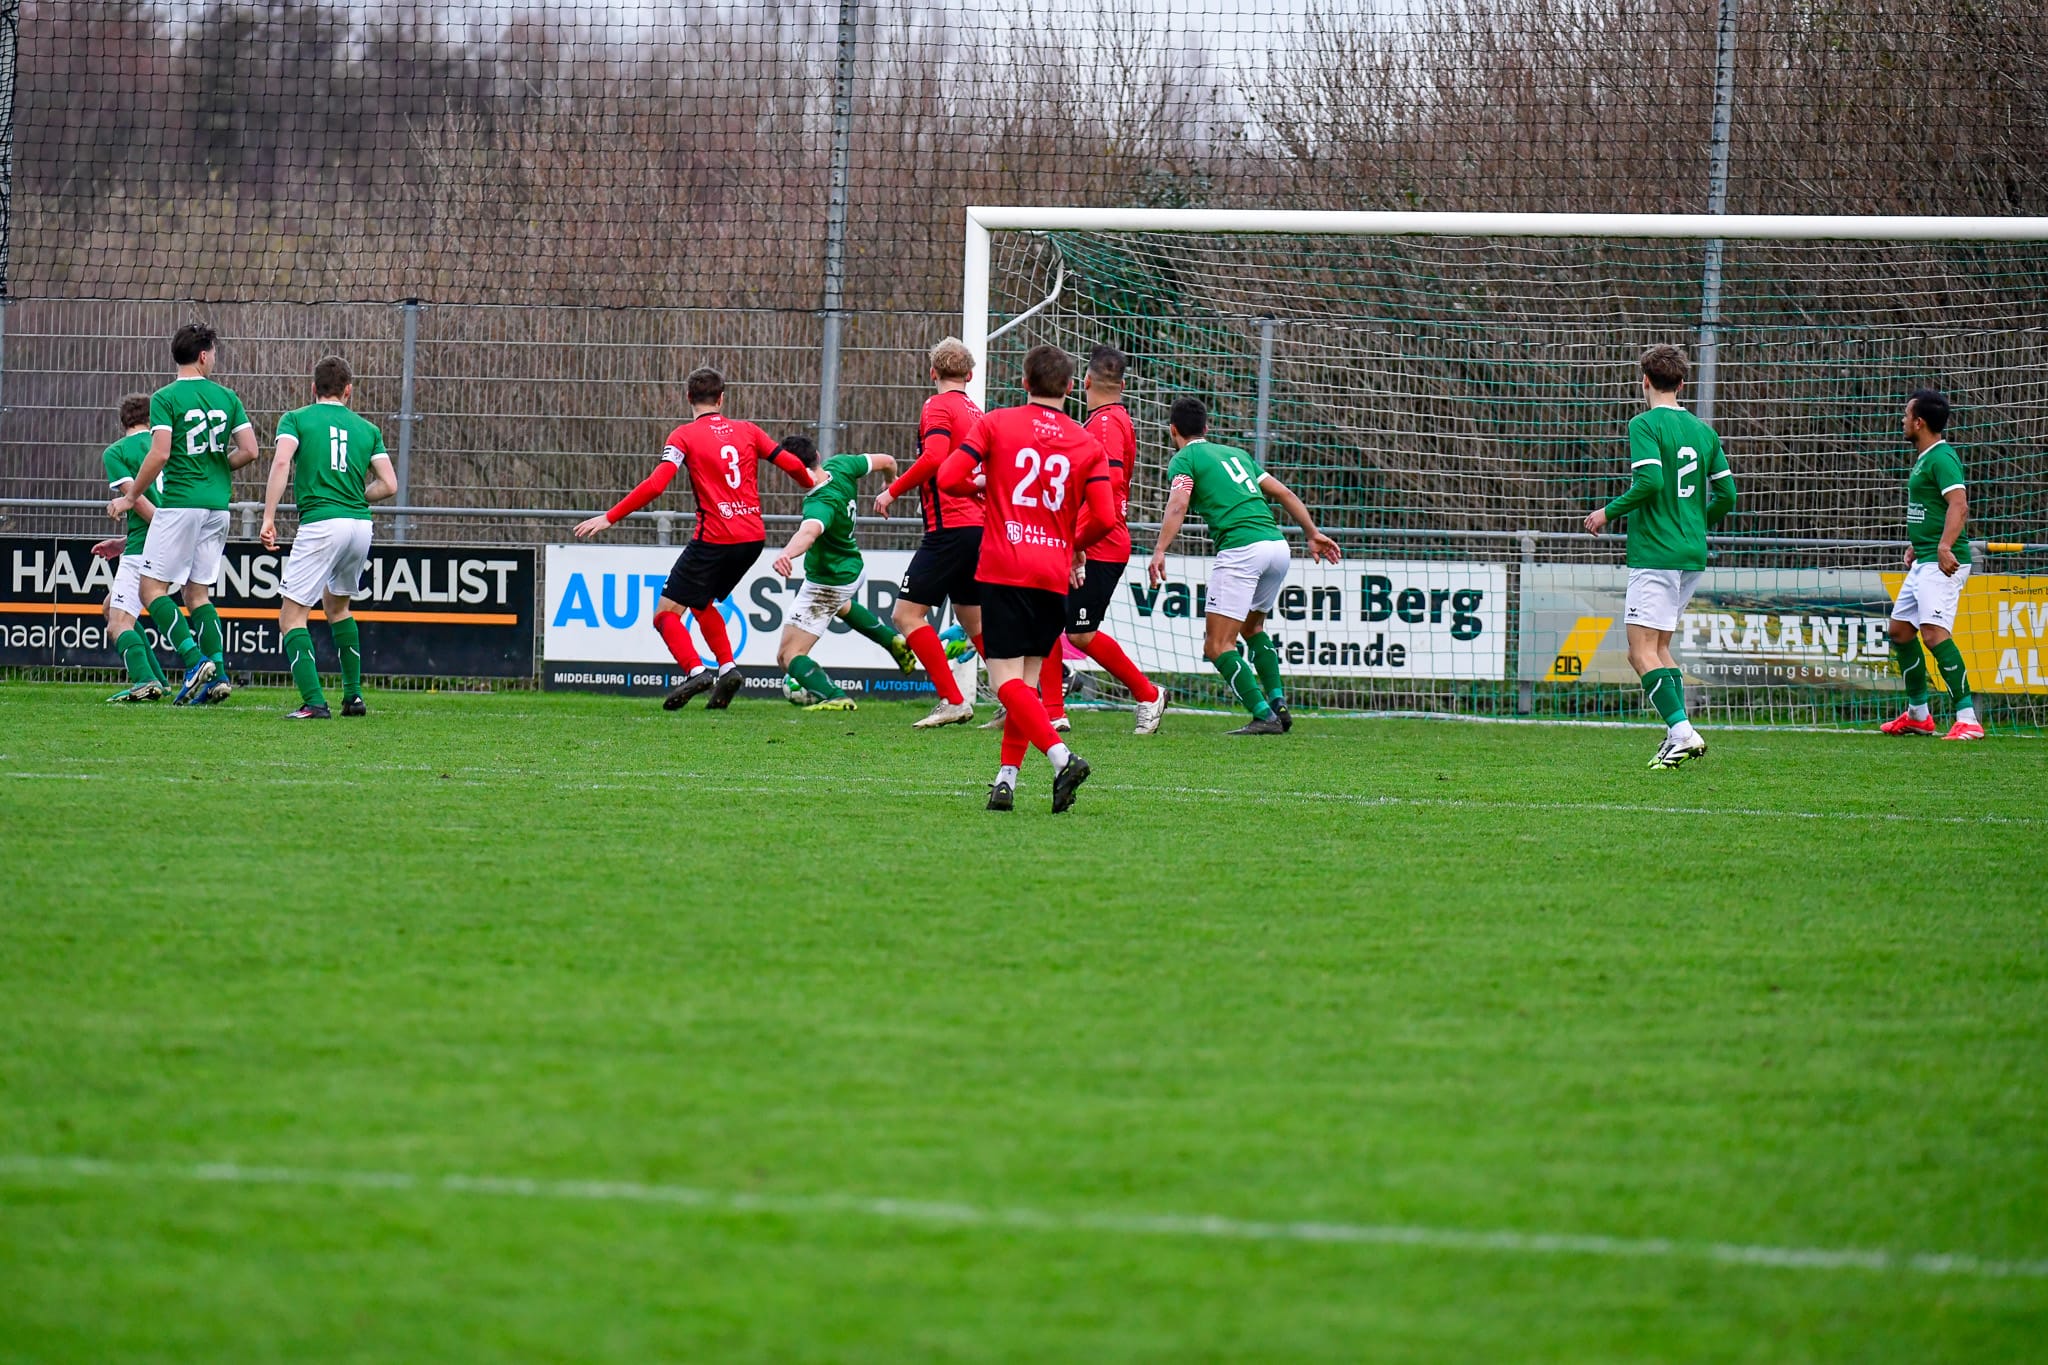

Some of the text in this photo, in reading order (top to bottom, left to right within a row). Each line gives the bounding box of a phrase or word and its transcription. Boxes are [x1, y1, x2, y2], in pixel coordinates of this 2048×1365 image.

[184, 408, 228, 456] 22
[329, 425, 348, 473] 11
[720, 444, 741, 490] 3
[1011, 447, 1071, 512] 23
[1221, 456, 1257, 494] 4
[1677, 446, 1698, 498] 2
[1025, 524, 1046, 536] ALL
[1025, 534, 1067, 549] SAFETY
[1266, 584, 1341, 621] en
[1360, 575, 1483, 641] Berg
[1680, 613, 1889, 662] FRAANJE
[554, 672, 625, 685] MIDDELBURG
[633, 674, 662, 686] GOES
[833, 679, 863, 691] REDA
